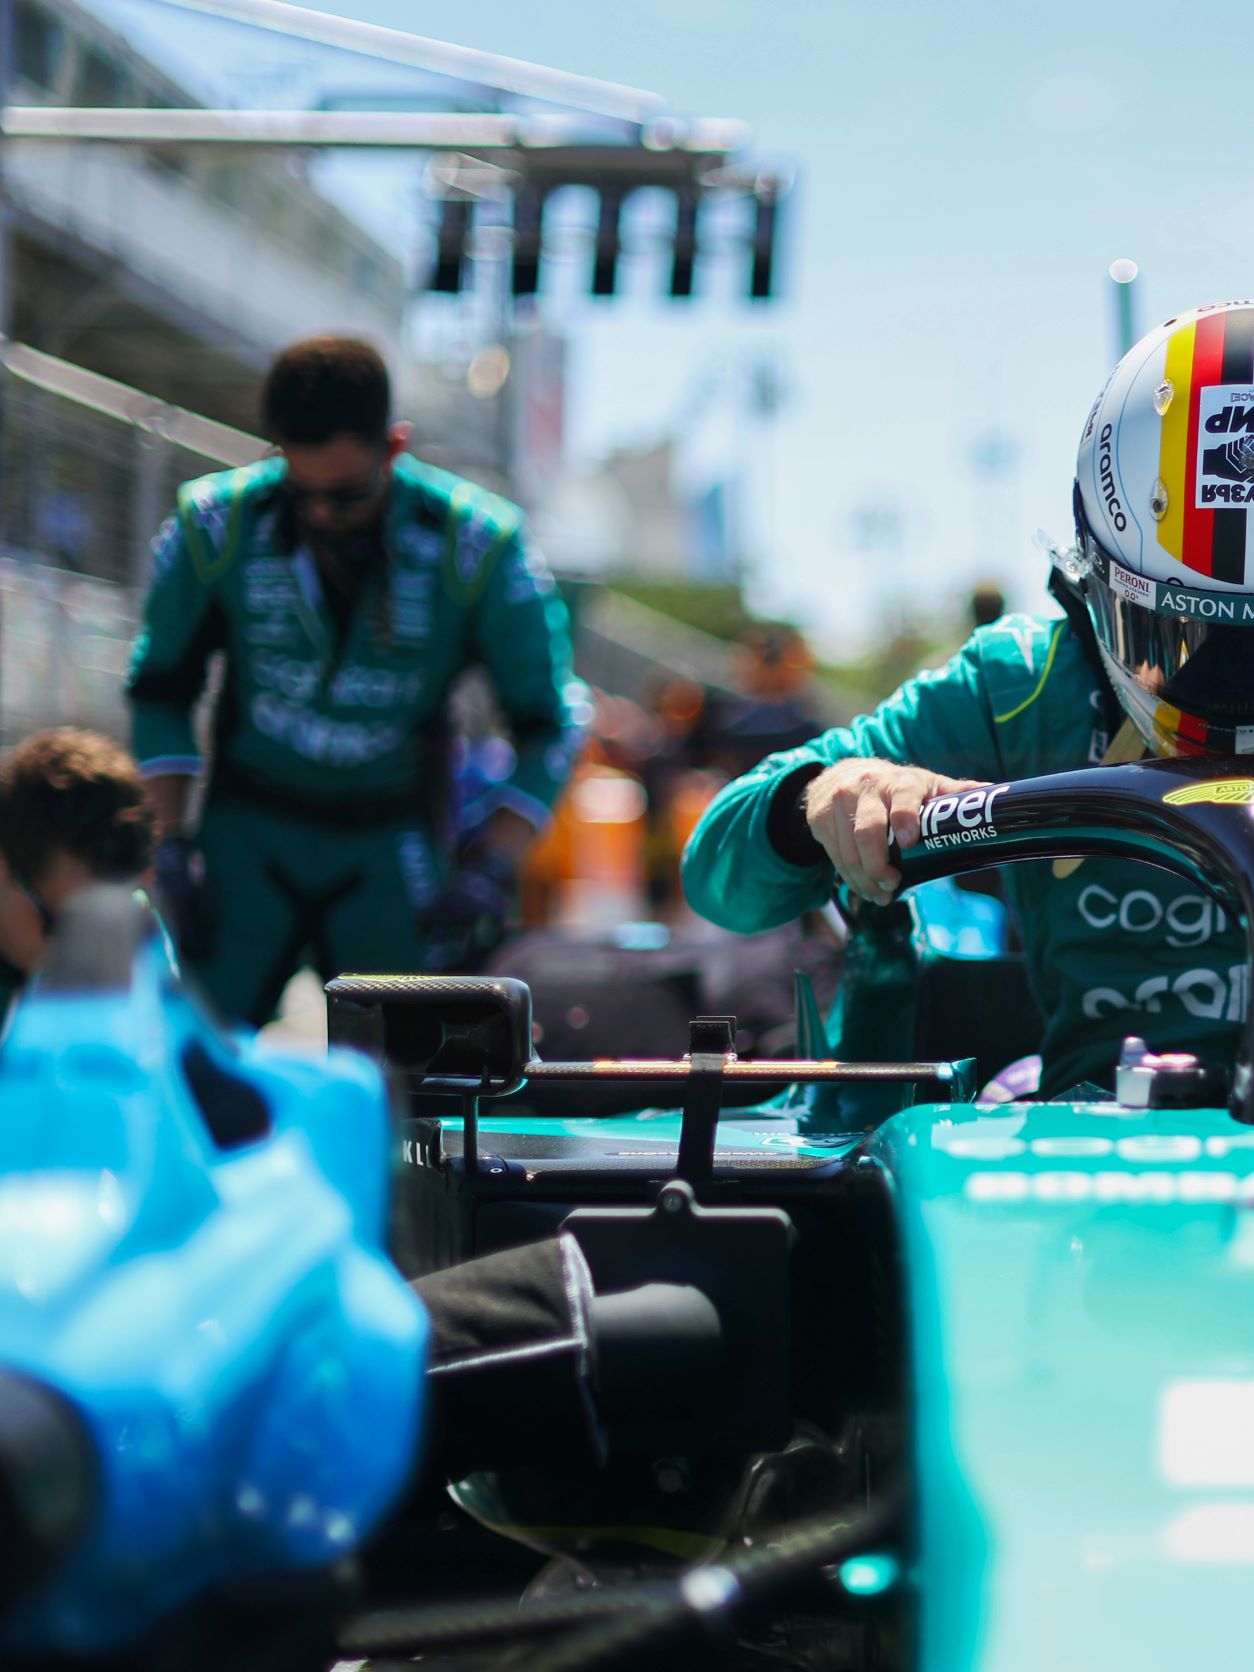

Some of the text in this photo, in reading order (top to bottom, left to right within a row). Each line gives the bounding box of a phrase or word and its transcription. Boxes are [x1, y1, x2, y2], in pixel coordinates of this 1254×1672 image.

[1100, 422, 1127, 532] aramco
[1114, 566, 1150, 593] PERONI
[1160, 591, 1234, 619] ASTON
[923, 825, 998, 850] NETWORKS
